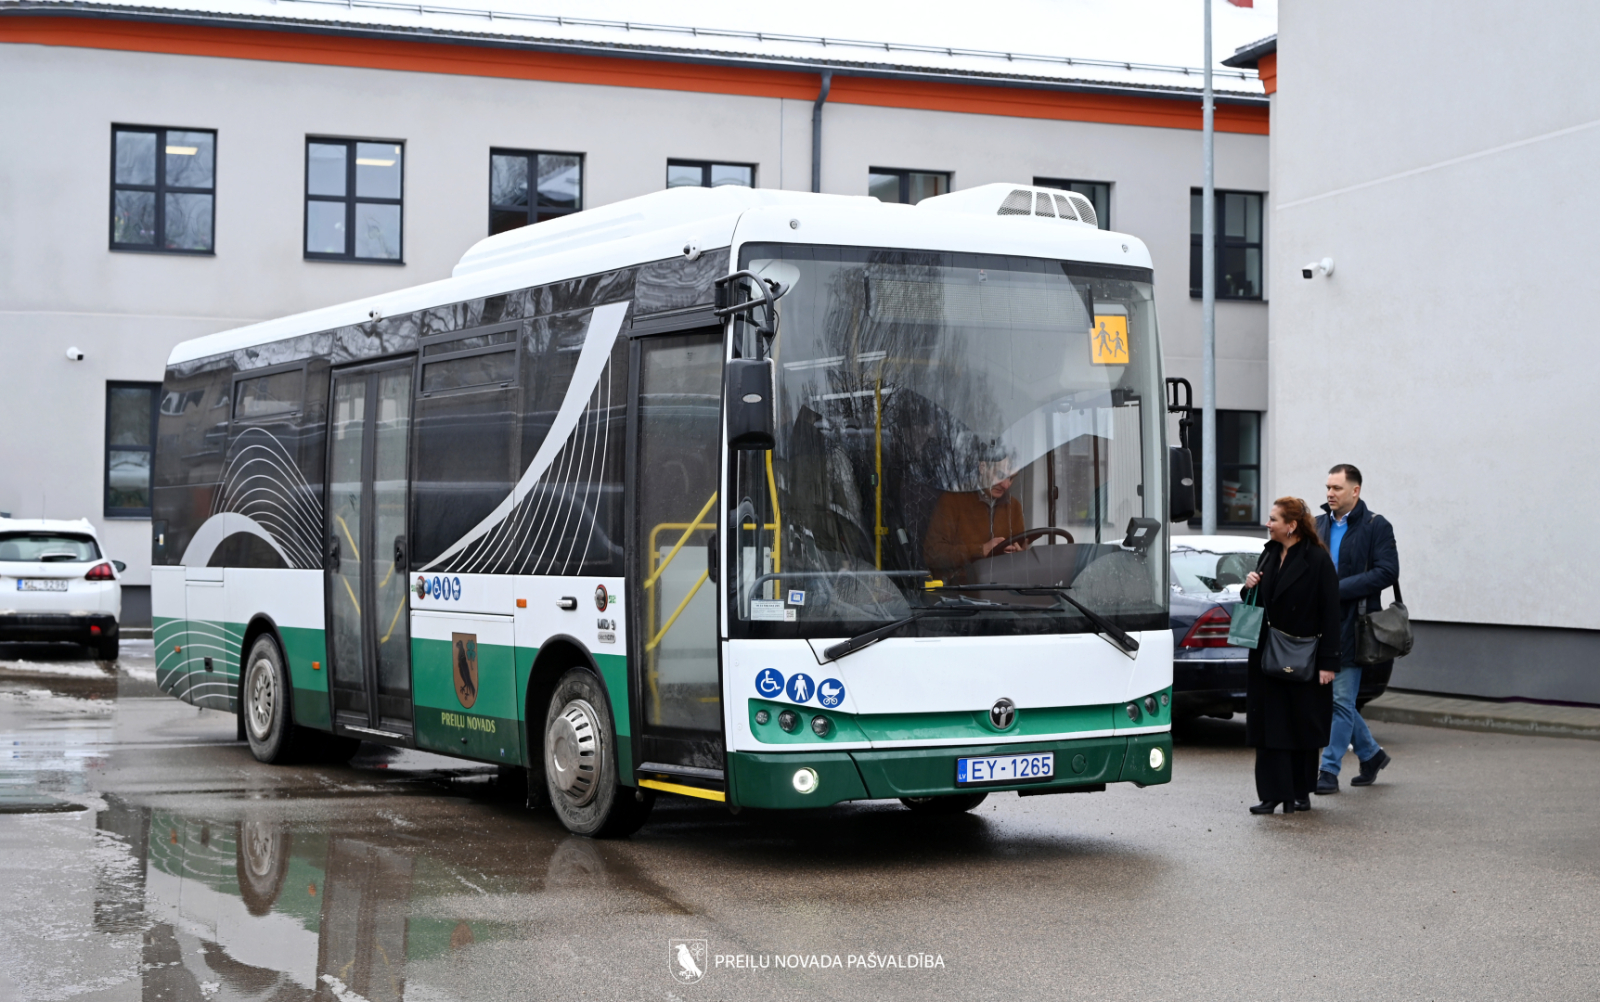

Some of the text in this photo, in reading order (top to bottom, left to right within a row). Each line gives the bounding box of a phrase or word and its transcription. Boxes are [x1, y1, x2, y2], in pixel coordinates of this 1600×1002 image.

[441, 711, 496, 734] PREIĻU NOVADS
[972, 756, 1051, 780] EY-1265
